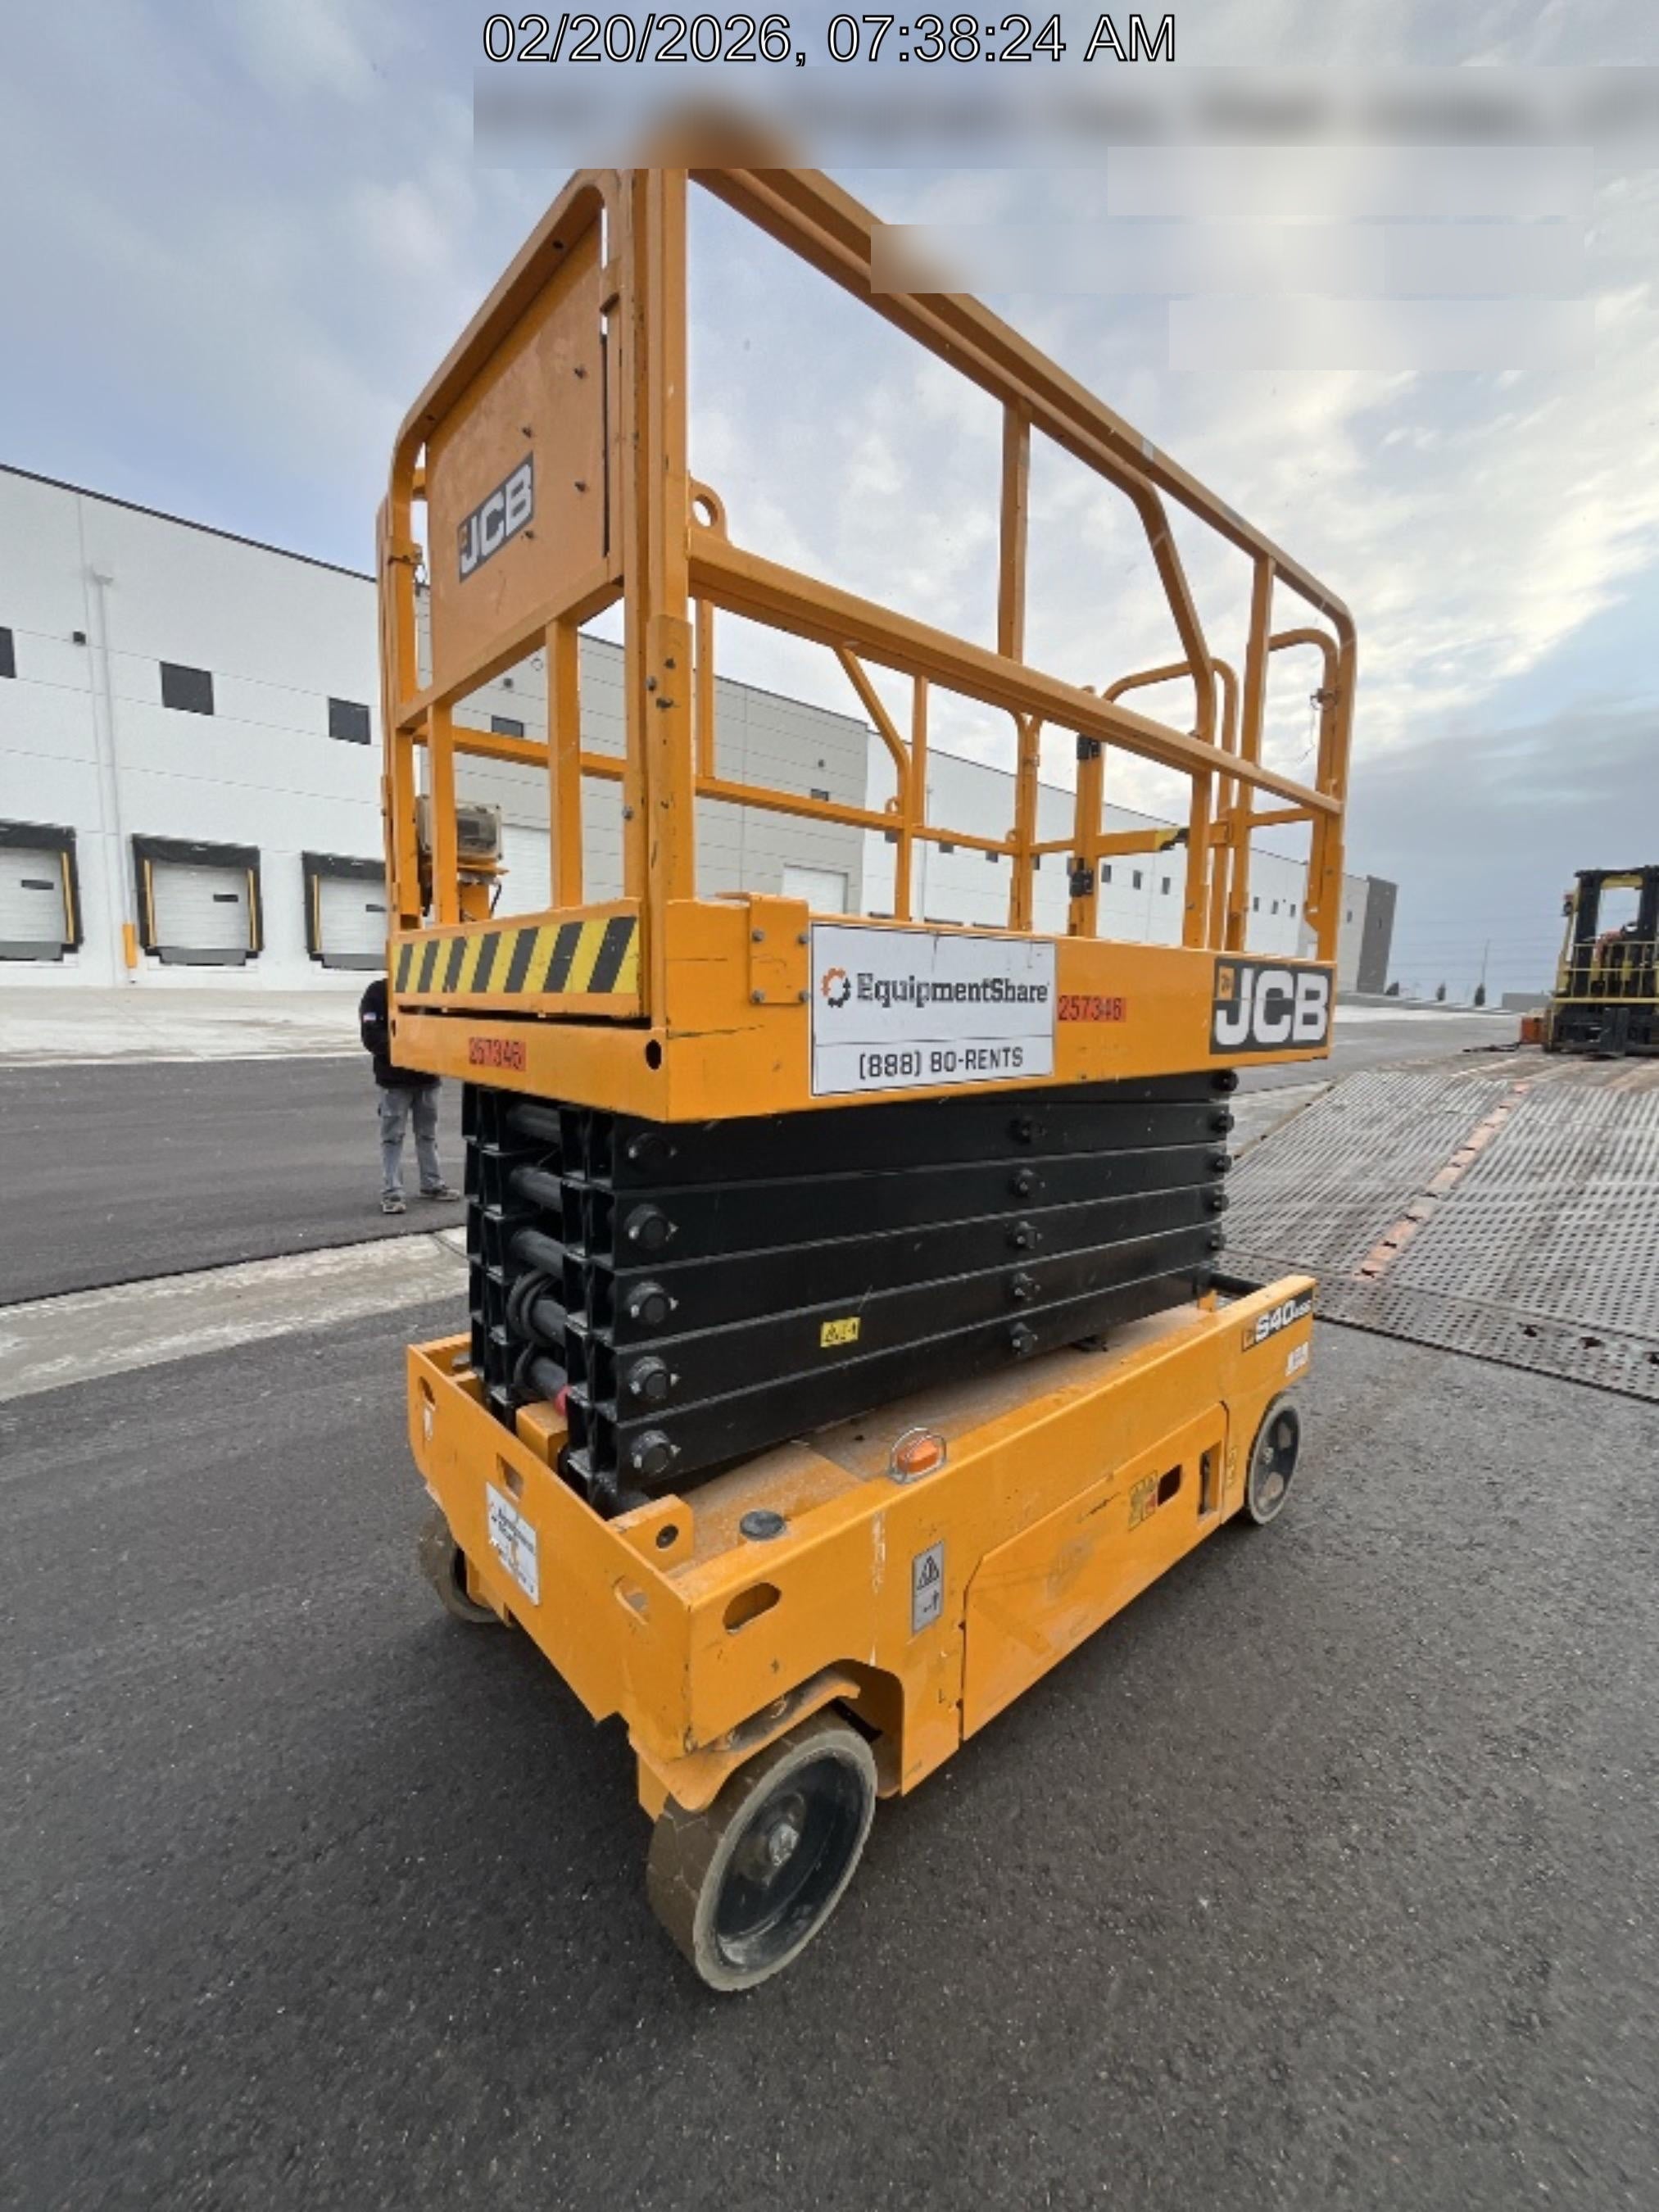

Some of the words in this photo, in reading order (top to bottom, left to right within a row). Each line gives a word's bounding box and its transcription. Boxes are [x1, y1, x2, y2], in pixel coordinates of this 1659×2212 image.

[460, 464, 533, 574] JCB
[857, 972, 1048, 1008] EquipmentShare
[1216, 968, 1329, 1045] JCB
[859, 1050, 921, 1079] (888)
